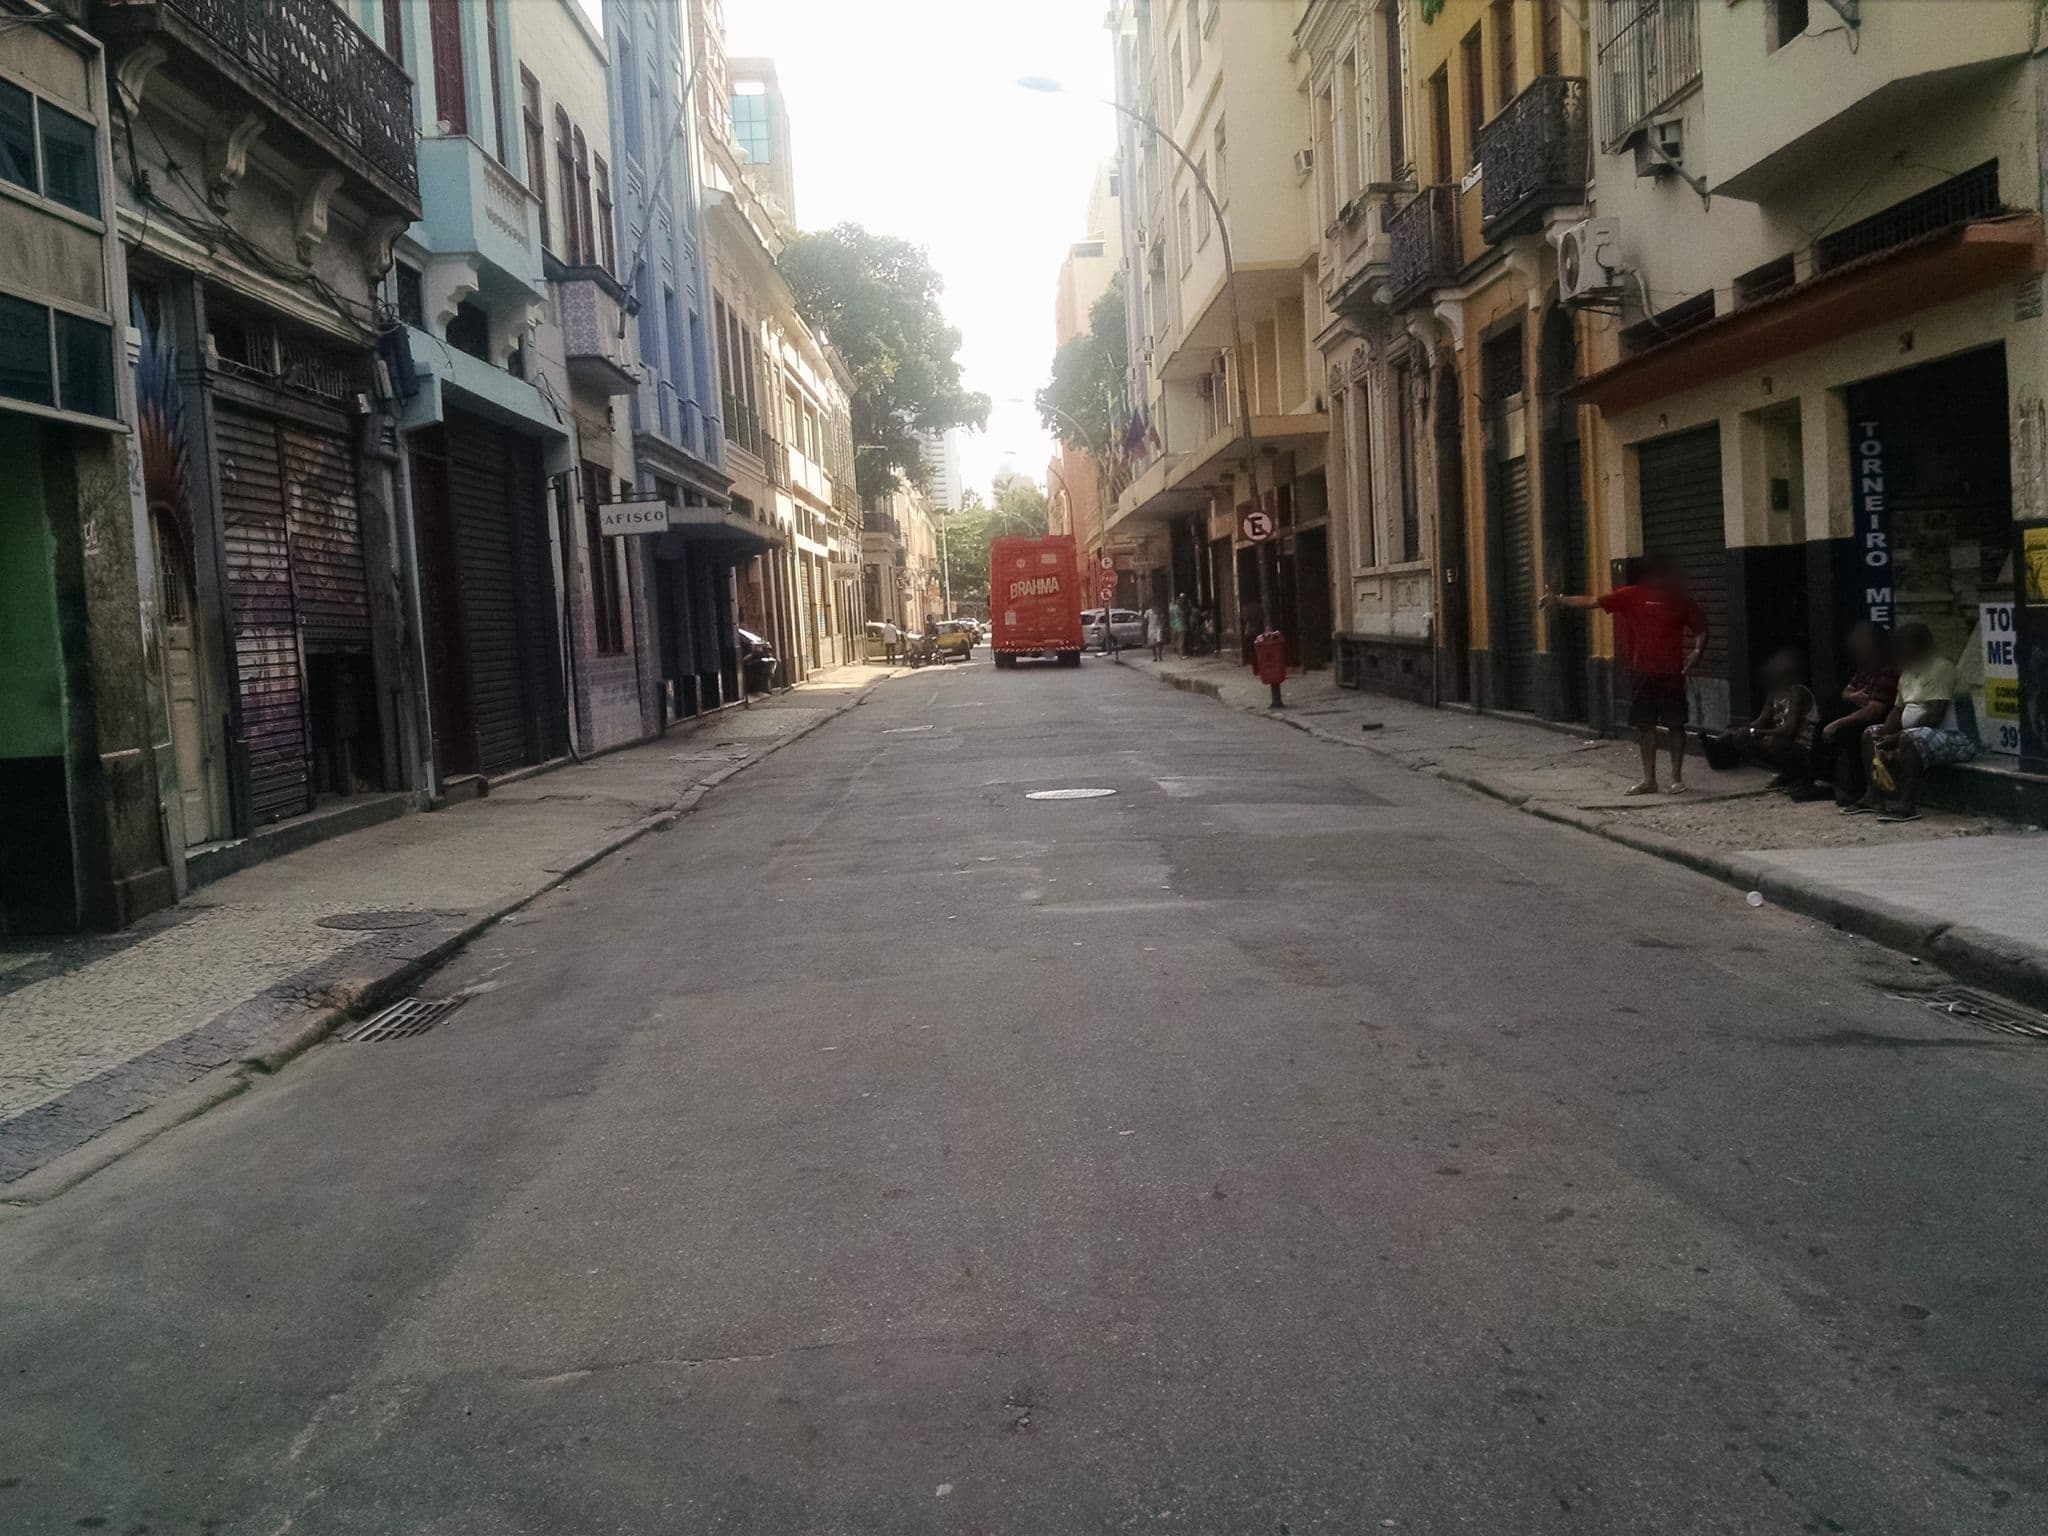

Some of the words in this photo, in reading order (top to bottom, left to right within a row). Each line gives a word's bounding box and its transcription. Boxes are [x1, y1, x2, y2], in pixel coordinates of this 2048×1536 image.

[1859, 421, 1889, 567] TORNEIRO
[605, 511, 664, 525] AFISCO
[1010, 576, 1060, 600] BRAHMA
[1865, 587, 1892, 630] ME
[1988, 641, 2018, 664] ME
[2000, 726, 2021, 748] 39
